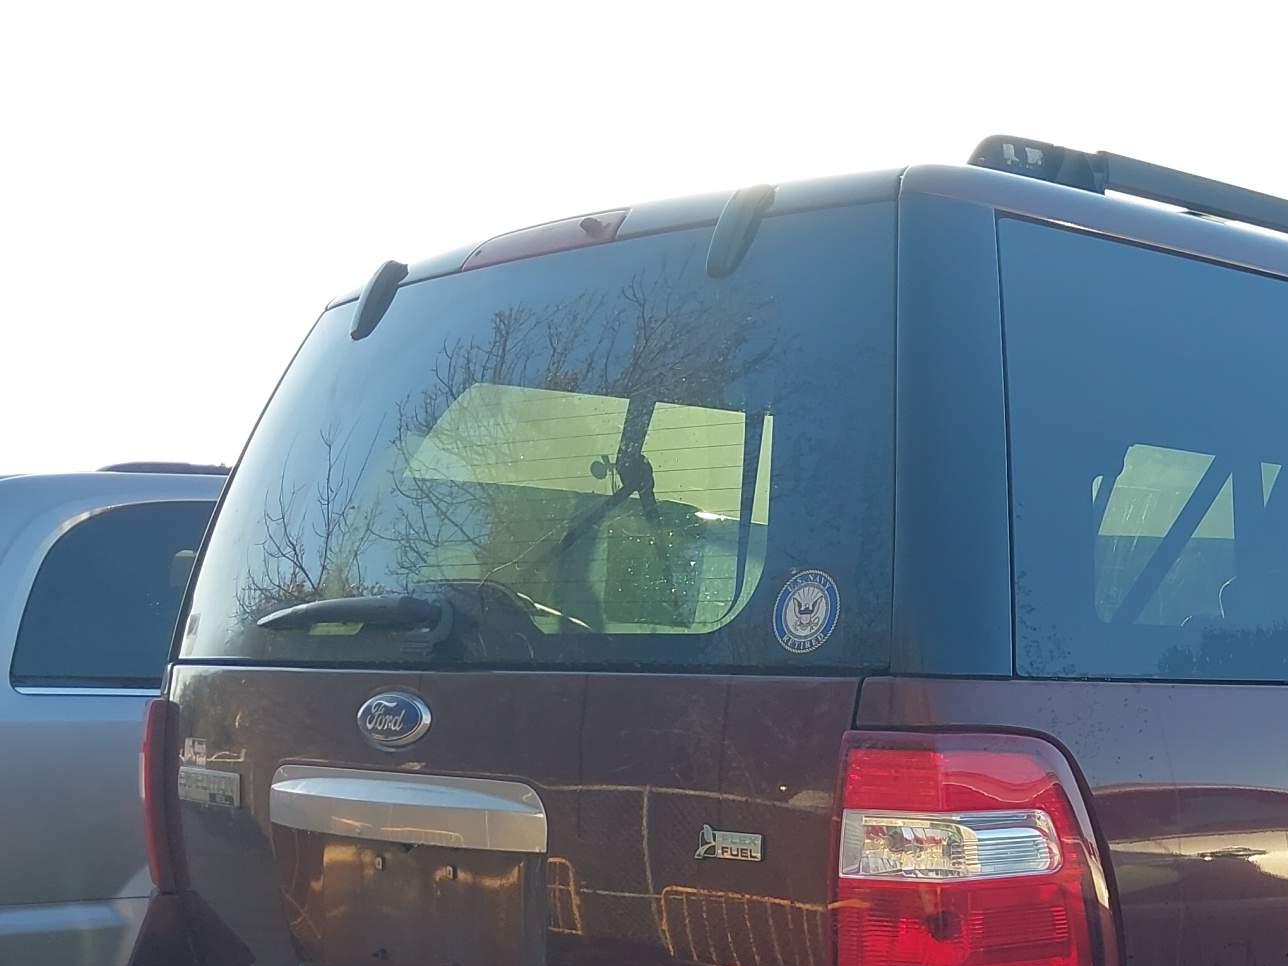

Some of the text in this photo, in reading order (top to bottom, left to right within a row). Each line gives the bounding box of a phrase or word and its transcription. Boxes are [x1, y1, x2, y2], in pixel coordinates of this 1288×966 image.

[782, 632, 824, 650] RETIRED
[366, 700, 406, 731] Ford
[721, 846, 760, 859] FUEL
